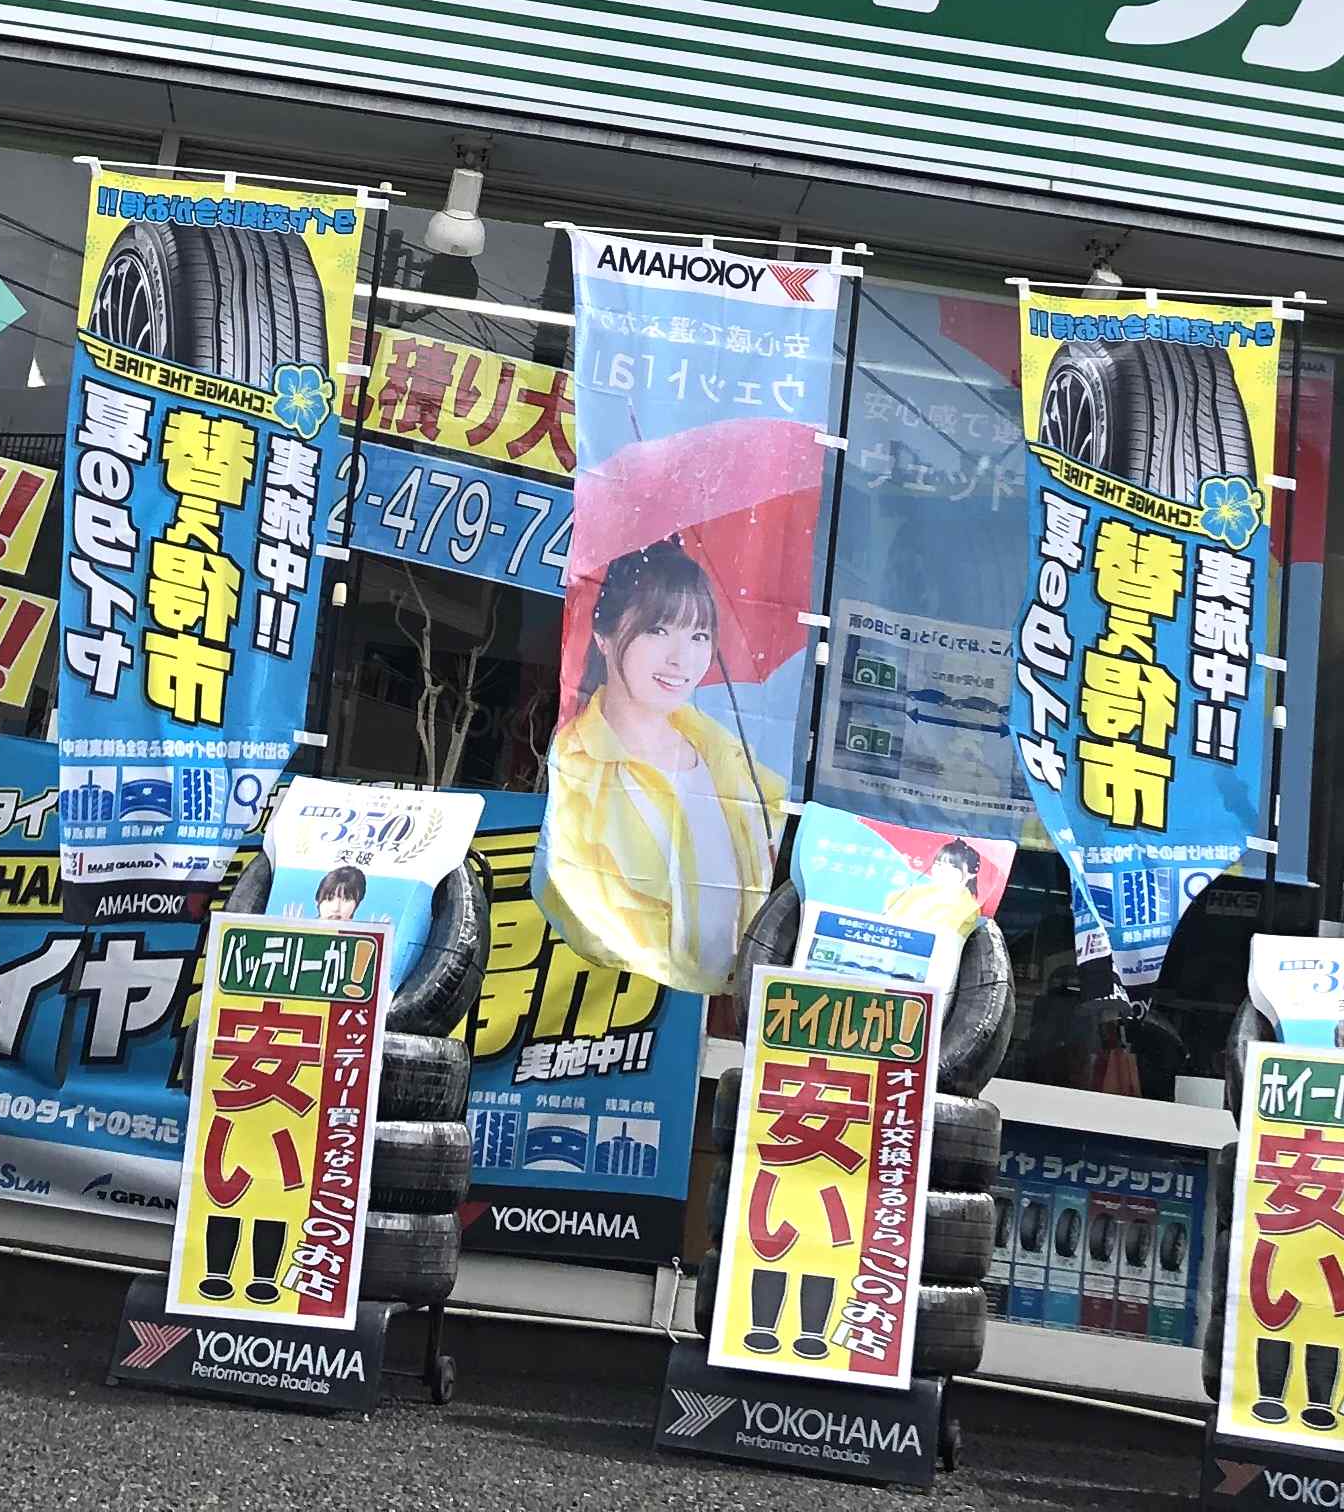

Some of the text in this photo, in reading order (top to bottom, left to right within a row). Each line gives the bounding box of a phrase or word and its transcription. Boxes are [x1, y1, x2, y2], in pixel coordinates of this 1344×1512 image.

[321, 808, 416, 843] 350
[222, 933, 376, 998] バッテリーが!
[767, 991, 924, 1058] オイルが!
[513, 1031, 654, 1084] 実施中!!
[282, 1008, 371, 1304] バッテリー買うならこのお店
[1042, 1154, 1195, 1200] ラインアップ!!
[491, 1206, 641, 1241] YOKOHAMA
[830, 1067, 920, 1362] オイル交換するならこのお店
[191, 1361, 332, 1395] Performance Radials
[195, 1327, 366, 1383] YOKOHAMA
[736, 1430, 872, 1466] Performance Radials
[738, 1397, 924, 1457] YOKOHAMA
